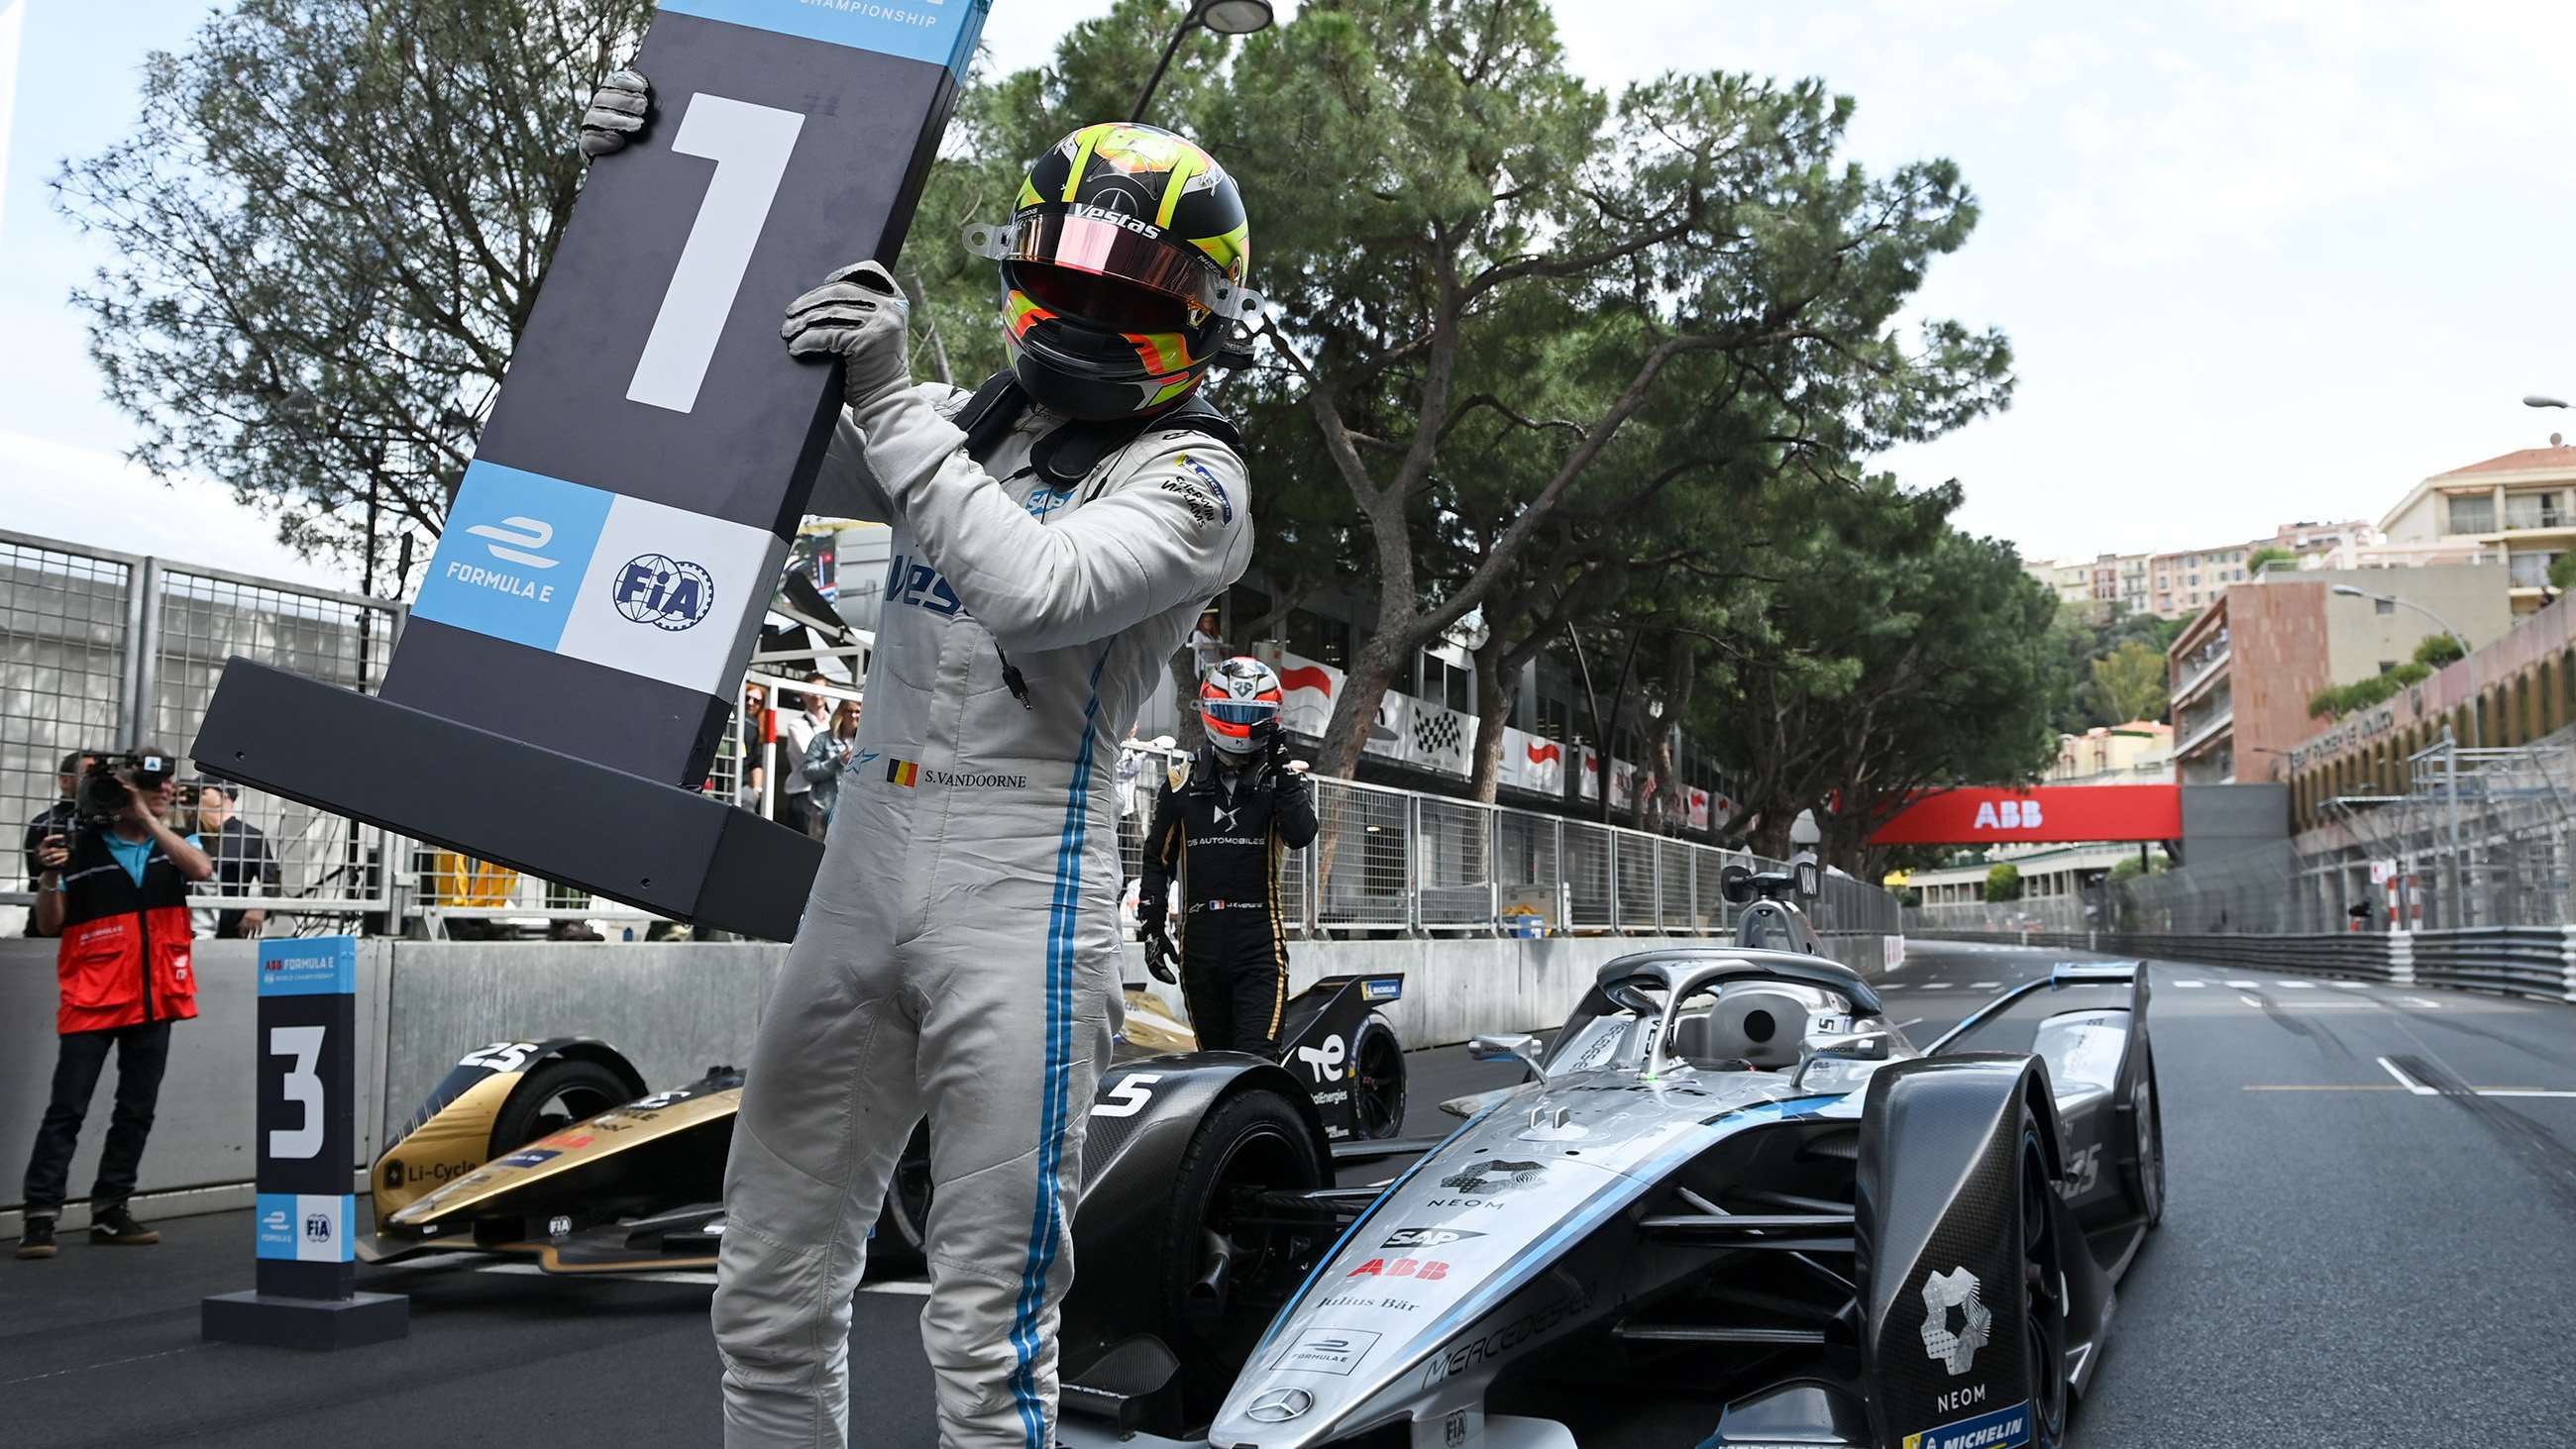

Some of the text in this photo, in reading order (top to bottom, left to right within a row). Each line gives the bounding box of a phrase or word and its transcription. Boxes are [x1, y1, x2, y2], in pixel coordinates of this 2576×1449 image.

[800, 0, 937, 29] HAMPIONSHIP
[1074, 203, 1161, 241] Vestas
[626, 92, 805, 414] 1
[447, 561, 555, 603] FORMULA E
[616, 563, 699, 621] FIA
[886, 555, 964, 616] Ves
[924, 770, 1027, 788] S.VANDOORNE
[1973, 800, 2043, 830] ABB
[1199, 836, 1265, 846] AUTOMOBILES
[283, 957, 326, 971] FORMULA
[327, 956, 334, 969] E
[458, 1042, 539, 1073] 25
[268, 1025, 326, 1159] 3
[1090, 1073, 1163, 1118] 5
[408, 1160, 477, 1183] Li-Cycle
[1427, 1197, 1505, 1211] NEOM
[306, 1218, 329, 1237] FIA
[549, 1219, 570, 1234] FIA
[1386, 1230, 1459, 1246] SAP
[1346, 1258, 1450, 1281] ABB
[1317, 1296, 1420, 1312] Julius Bär
[1937, 1384, 1986, 1413] NEOM
[1446, 1414, 1466, 1442] FIA
[1943, 1417, 2023, 1449] MICHELIN
